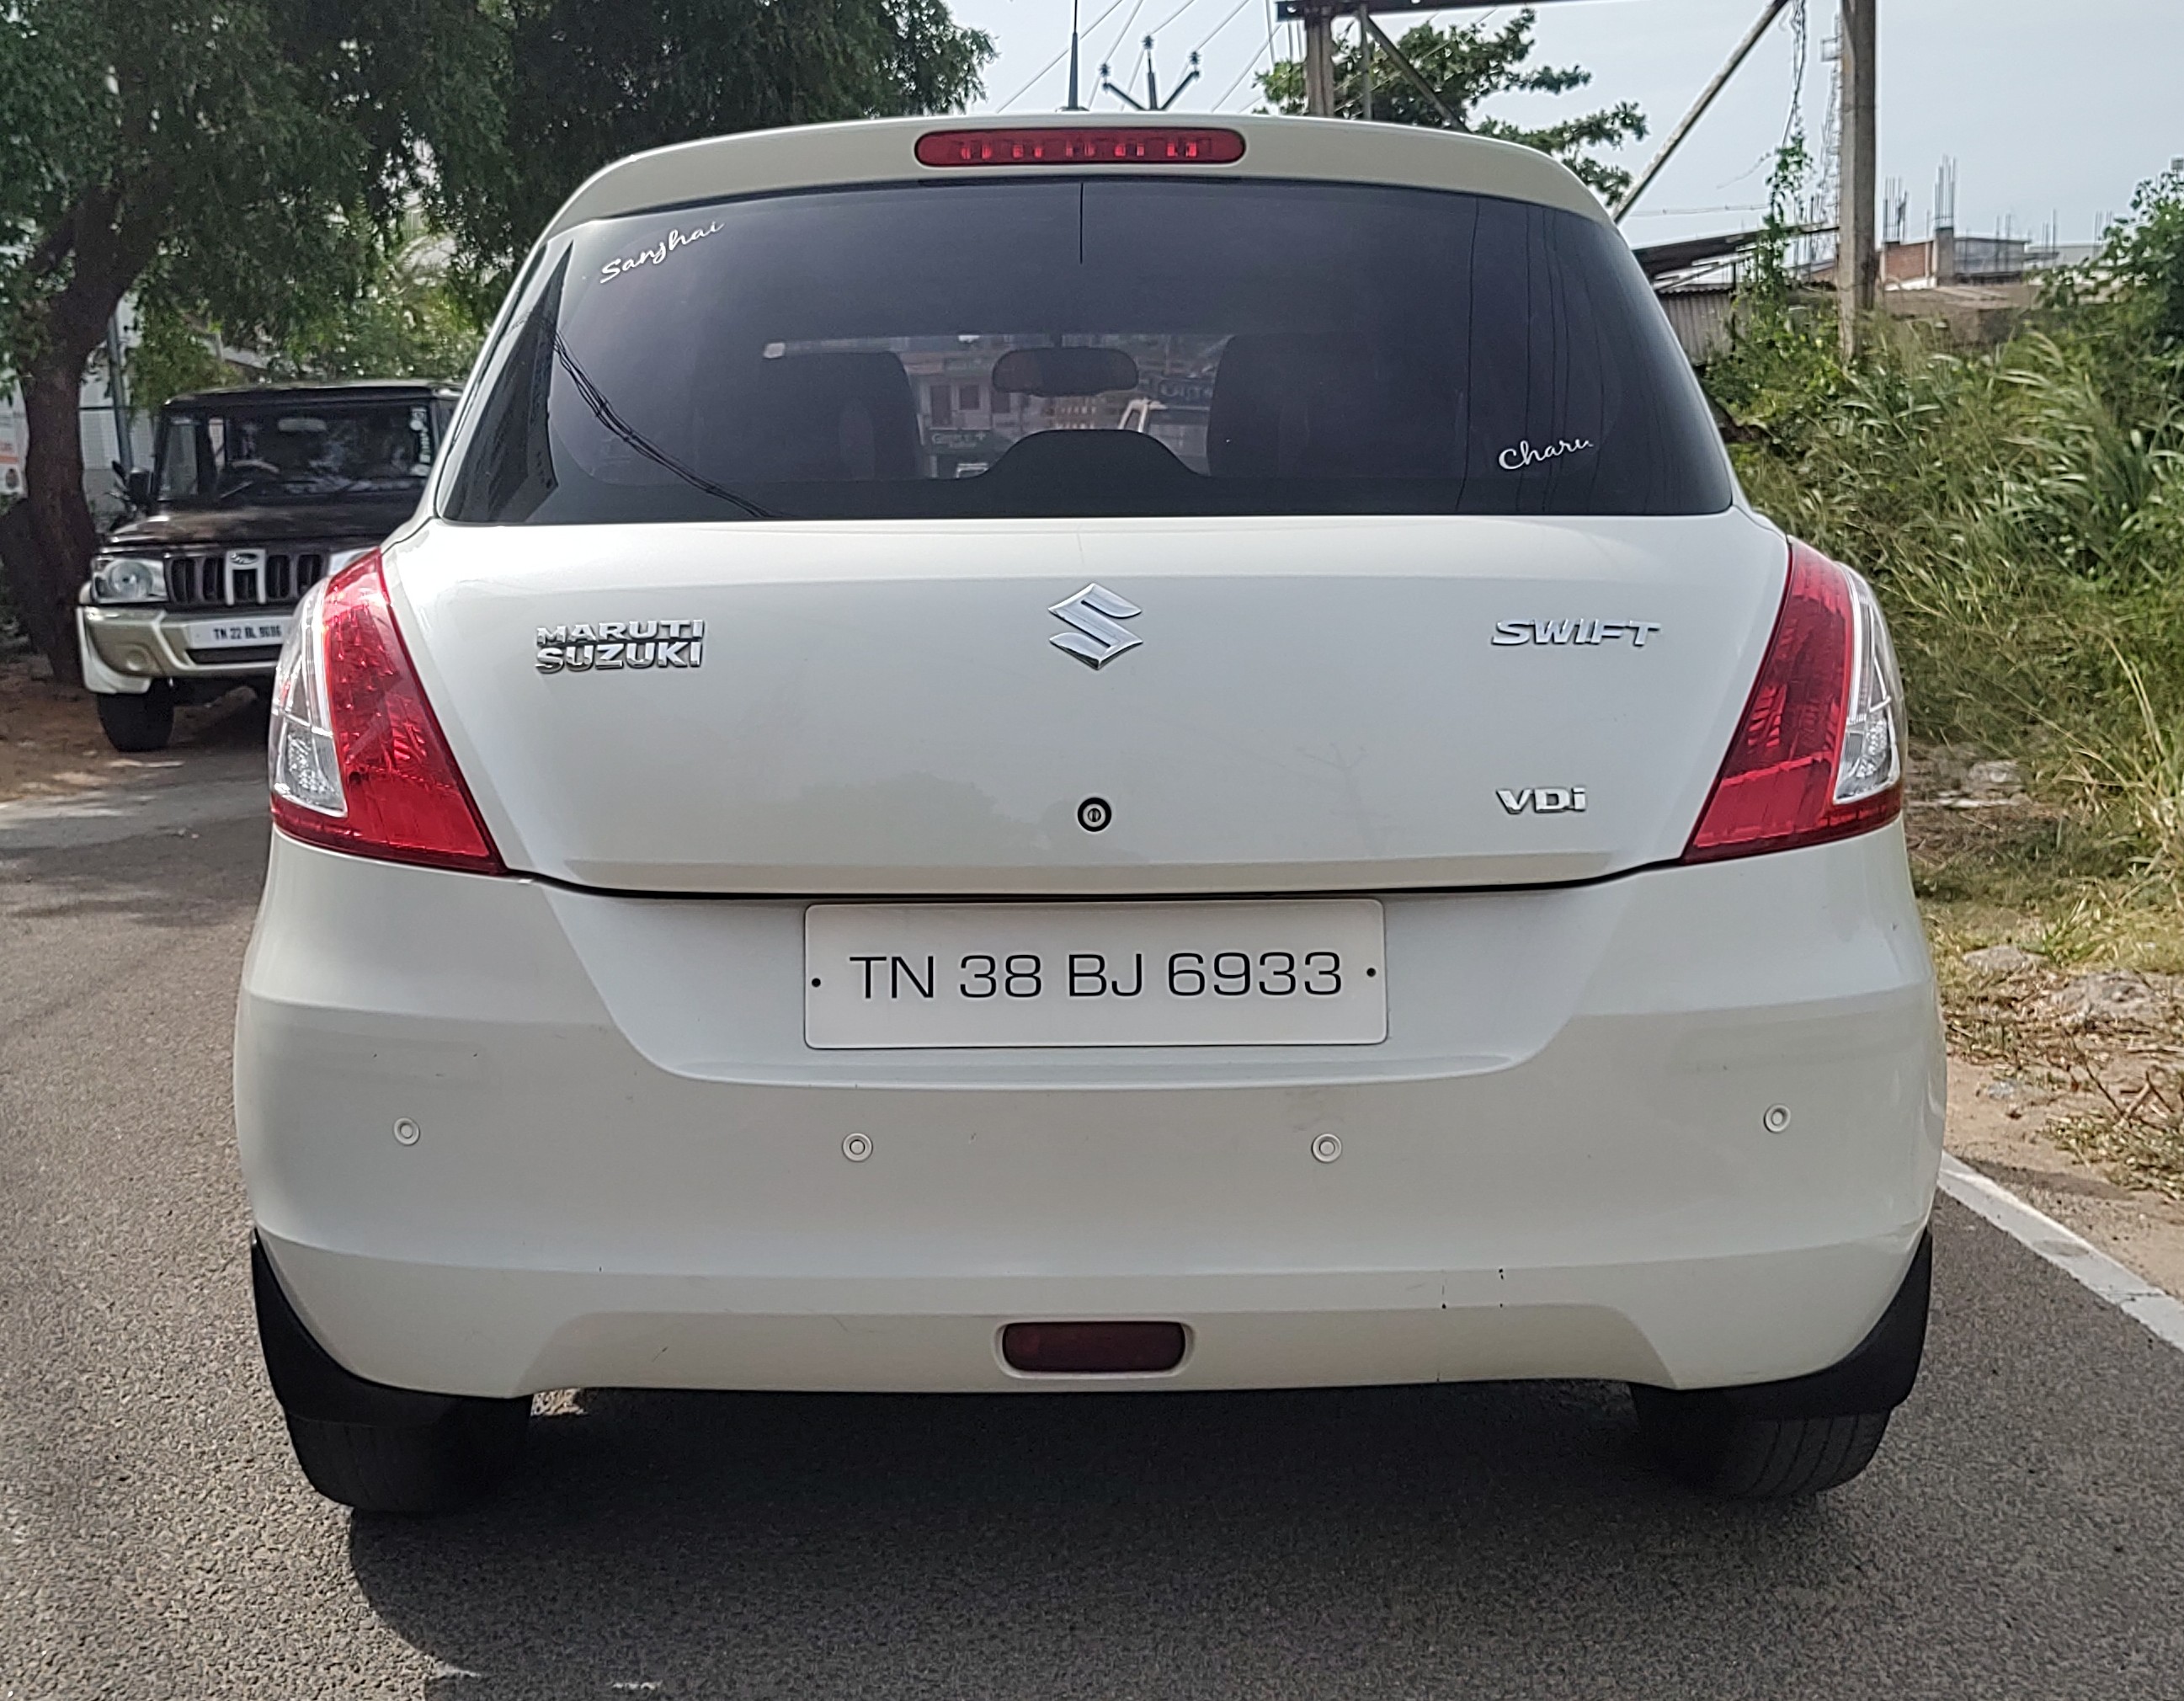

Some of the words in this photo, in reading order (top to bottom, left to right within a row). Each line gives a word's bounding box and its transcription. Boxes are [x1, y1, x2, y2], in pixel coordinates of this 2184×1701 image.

[213, 627, 228, 640] TN
[535, 618, 705, 646] MARUTI
[1491, 617, 1662, 647] SWIFT
[535, 641, 703, 674] SUZUKI
[1495, 787, 1586, 815] VDi
[849, 956, 934, 999] TN
[959, 954, 1041, 998] 38
[1068, 953, 1143, 997] BJ
[1167, 952, 1342, 996] 6933
